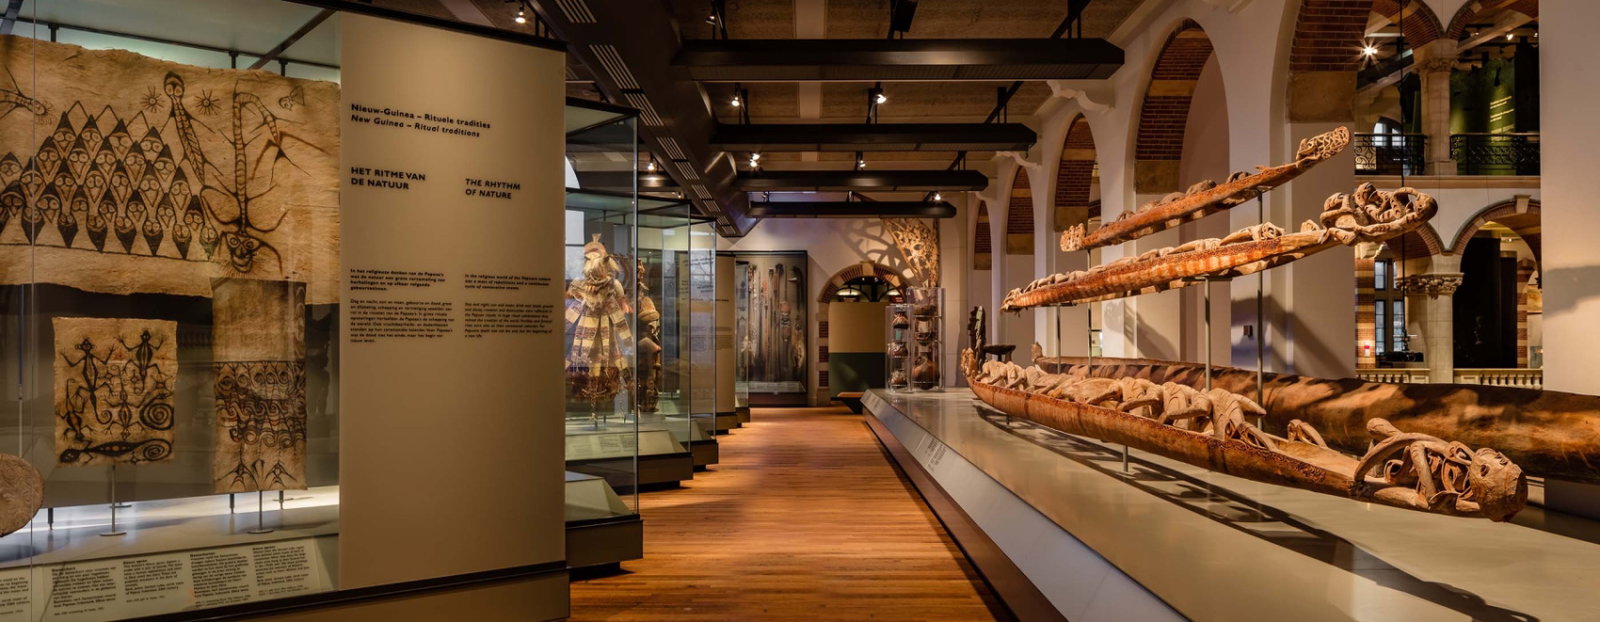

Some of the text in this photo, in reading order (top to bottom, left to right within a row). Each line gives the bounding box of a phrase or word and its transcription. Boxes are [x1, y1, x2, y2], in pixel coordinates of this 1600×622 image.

[351, 103, 415, 119] Nieuw-Guinea
[424, 113, 454, 124] Rituele
[456, 118, 490, 129] tradities
[351, 114, 370, 123] New
[374, 117, 404, 128] Guinea
[414, 122, 439, 132] Ritual
[442, 126, 480, 138] traditions
[351, 166, 426, 181] HET RITME VAN
[351, 178, 409, 190] DE NATUUR
[465, 178, 521, 190] THE RHYTHM
[465, 188, 512, 200] OF NATURE
